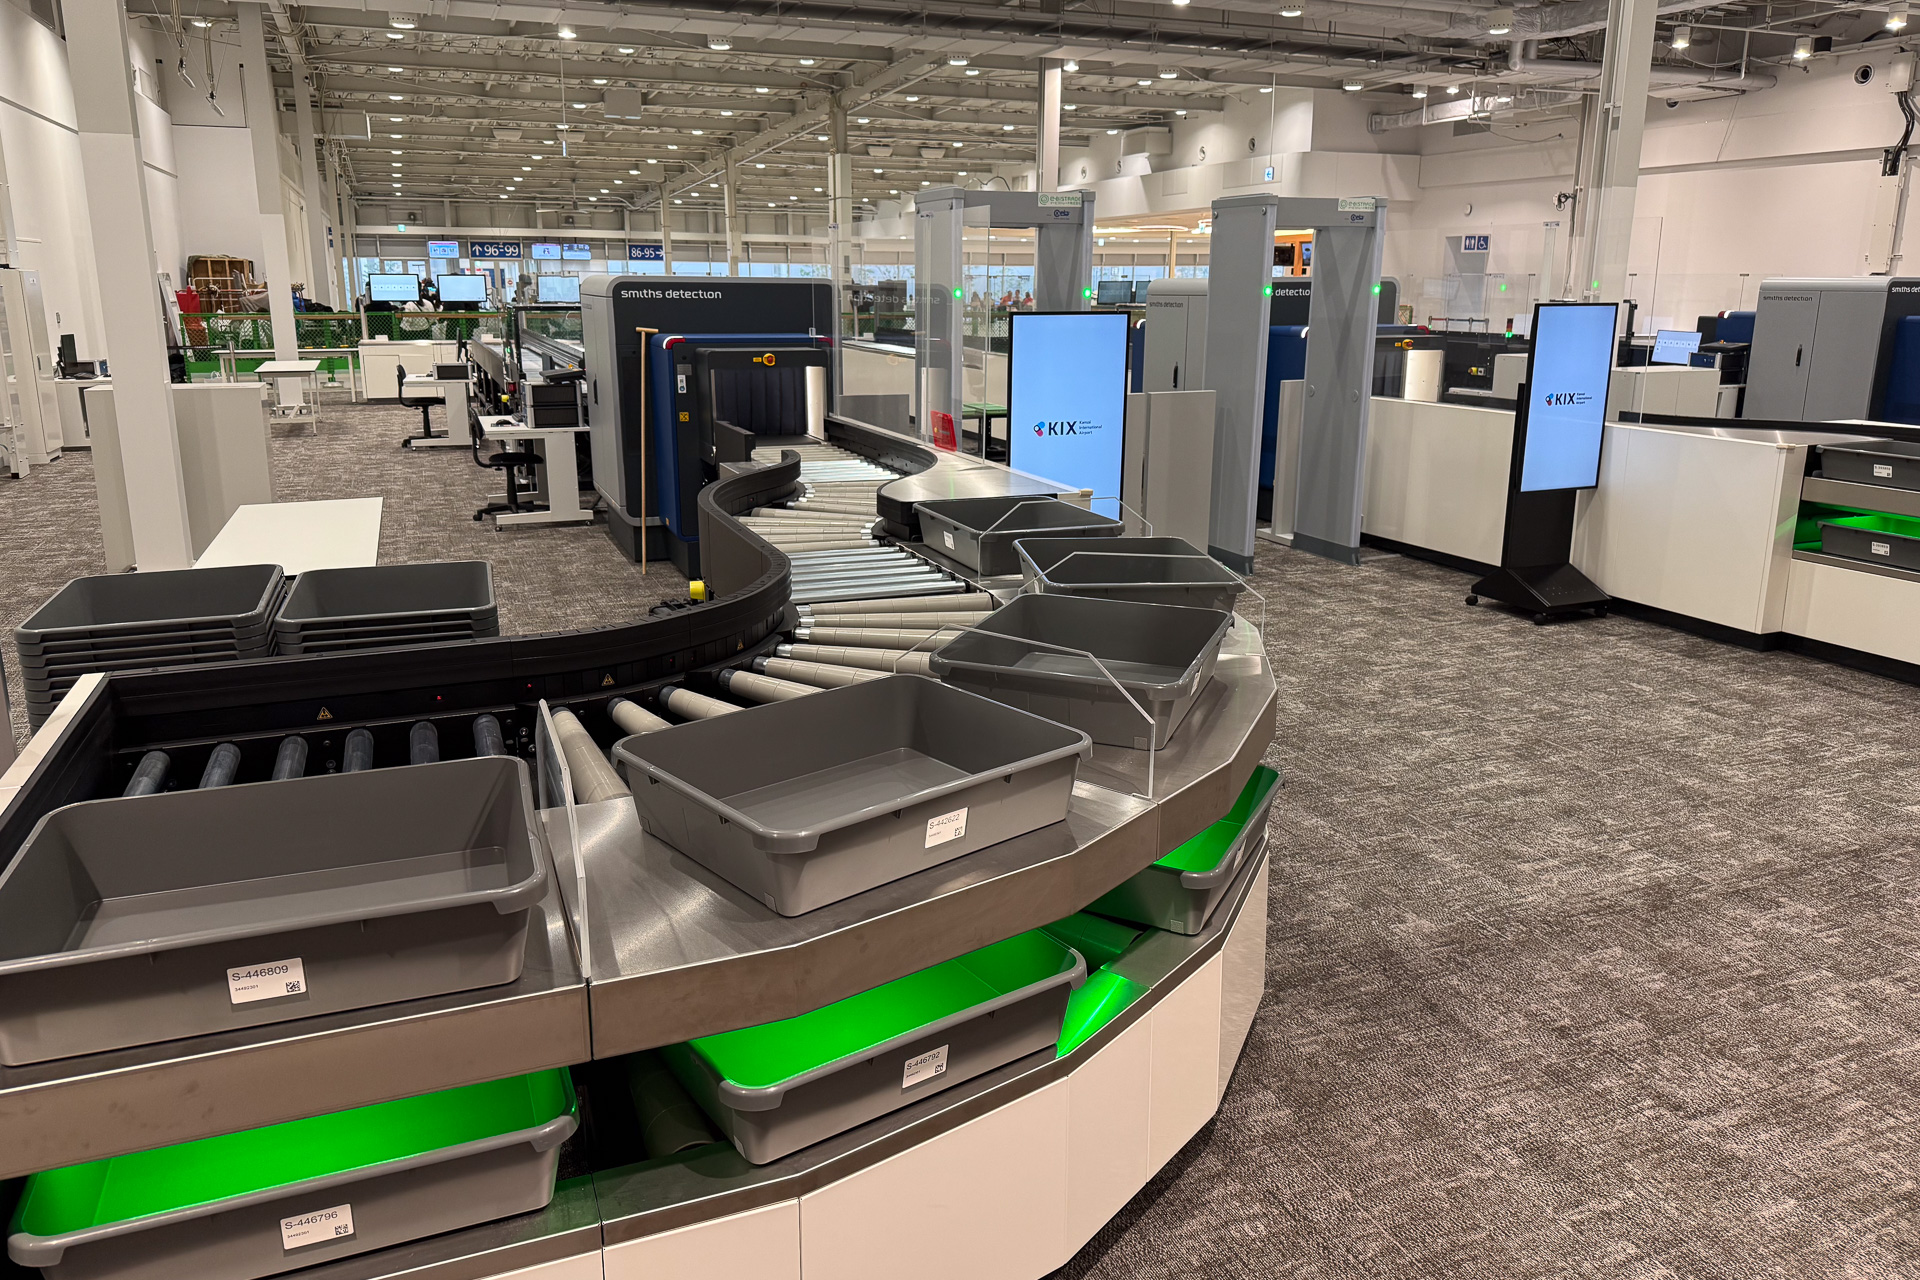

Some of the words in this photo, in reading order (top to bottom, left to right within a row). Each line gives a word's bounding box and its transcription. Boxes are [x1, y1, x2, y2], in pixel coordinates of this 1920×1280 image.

[484, 244, 520, 257] 96-99
[631, 247, 656, 258] 86-95
[620, 289, 663, 299] smiths
[665, 289, 723, 299] detection
[1275, 288, 1311, 296] detectio
[1555, 392, 1576, 406] KIX
[1048, 420, 1077, 436] KIX
[231, 964, 289, 982] S-446809
[906, 1051, 941, 1070] S-446792
[284, 1210, 338, 1230] S-446796
